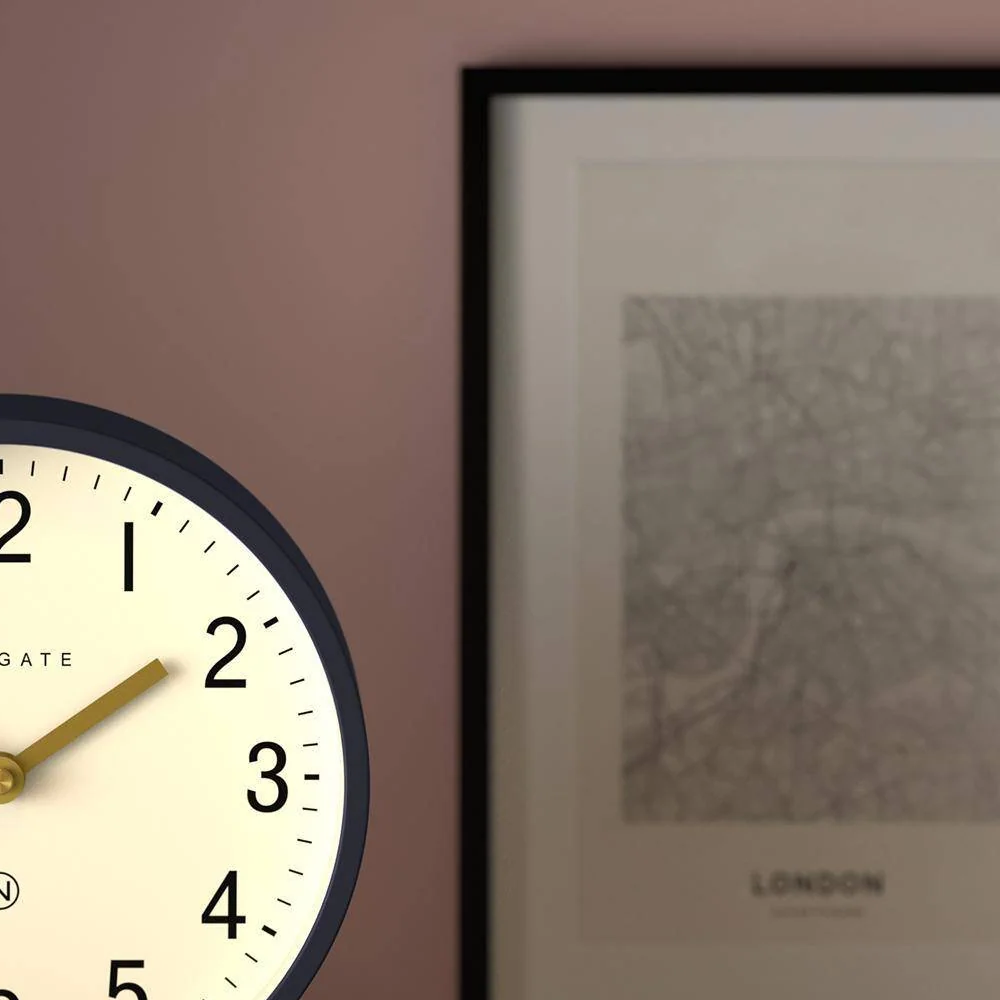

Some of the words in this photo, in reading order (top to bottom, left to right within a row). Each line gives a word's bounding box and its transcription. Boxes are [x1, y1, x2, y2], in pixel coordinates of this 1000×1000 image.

[124, 522, 133, 591] 1
[205, 617, 246, 688] 2
[247, 742, 288, 812] 3
[202, 871, 245, 939] 4
[751, 871, 885, 896] LONDON
